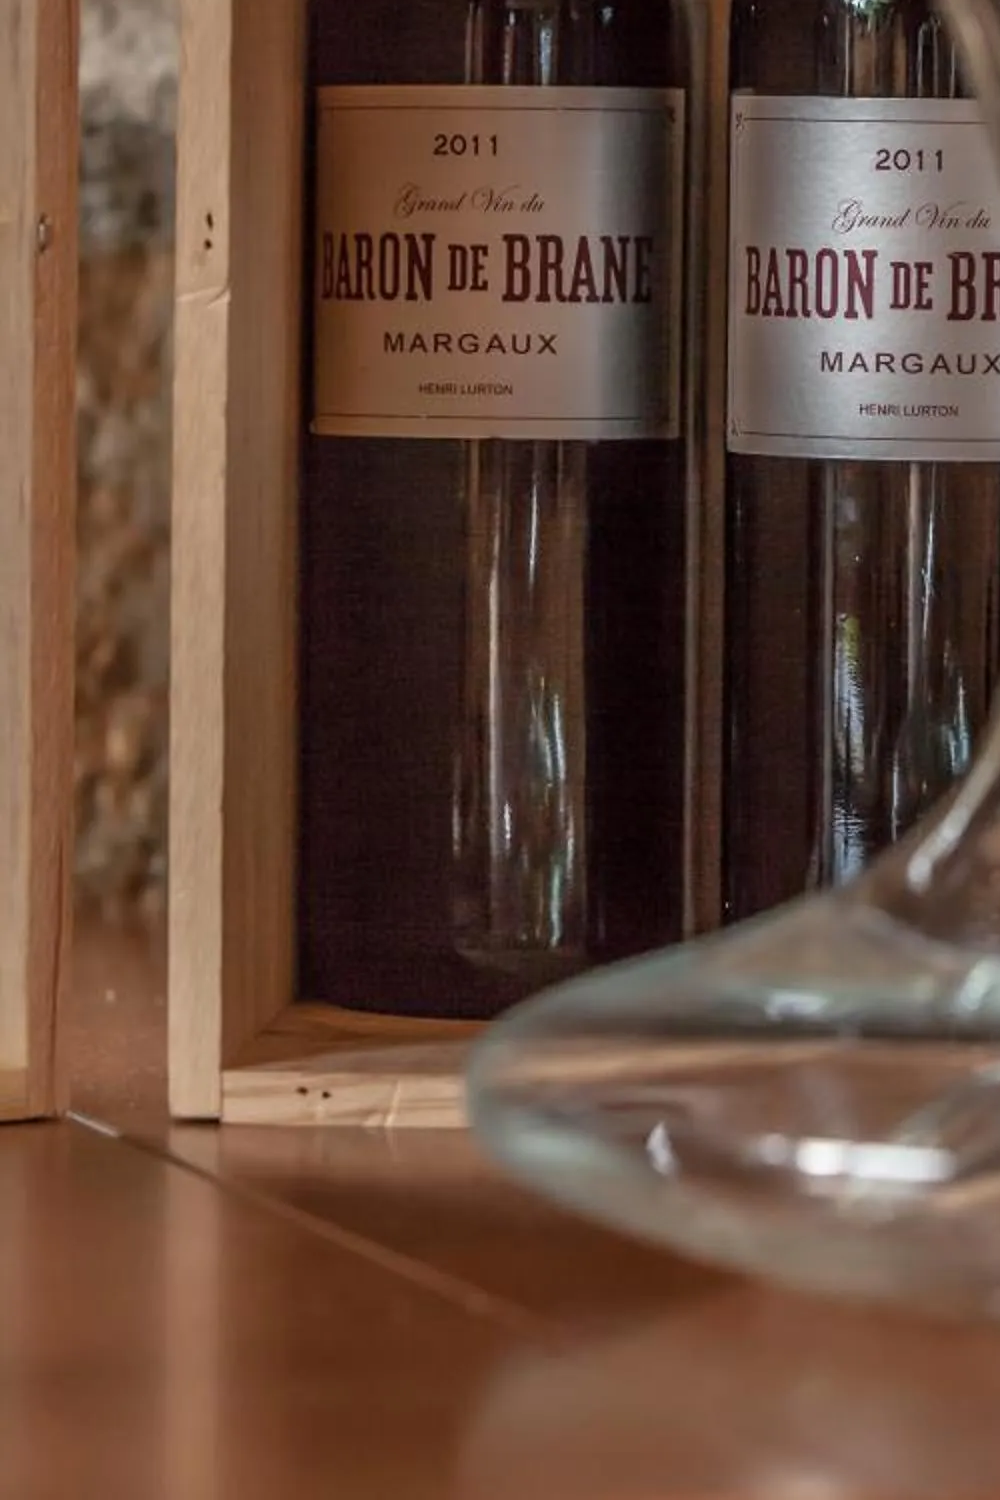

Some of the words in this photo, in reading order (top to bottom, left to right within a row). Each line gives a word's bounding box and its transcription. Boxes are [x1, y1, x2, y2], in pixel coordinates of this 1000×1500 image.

[433, 133, 498, 157] 2011
[875, 148, 943, 173] 2011
[393, 181, 467, 219] Grand
[471, 183, 518, 213] Vin
[520, 192, 545, 213] du
[832, 197, 911, 235] Grand
[915, 201, 960, 230] Vin
[965, 207, 991, 230] du
[321, 231, 436, 301] BARON
[447, 244, 489, 292] DE
[502, 233, 655, 304] BRANE
[745, 246, 878, 319] BARON
[890, 261, 933, 311] DE
[384, 331, 558, 355] MARGAUX
[419, 382, 457, 395] HENRI
[460, 383, 514, 396] LURTON
[859, 404, 899, 416] HENRI
[903, 404, 958, 418] LURTON
